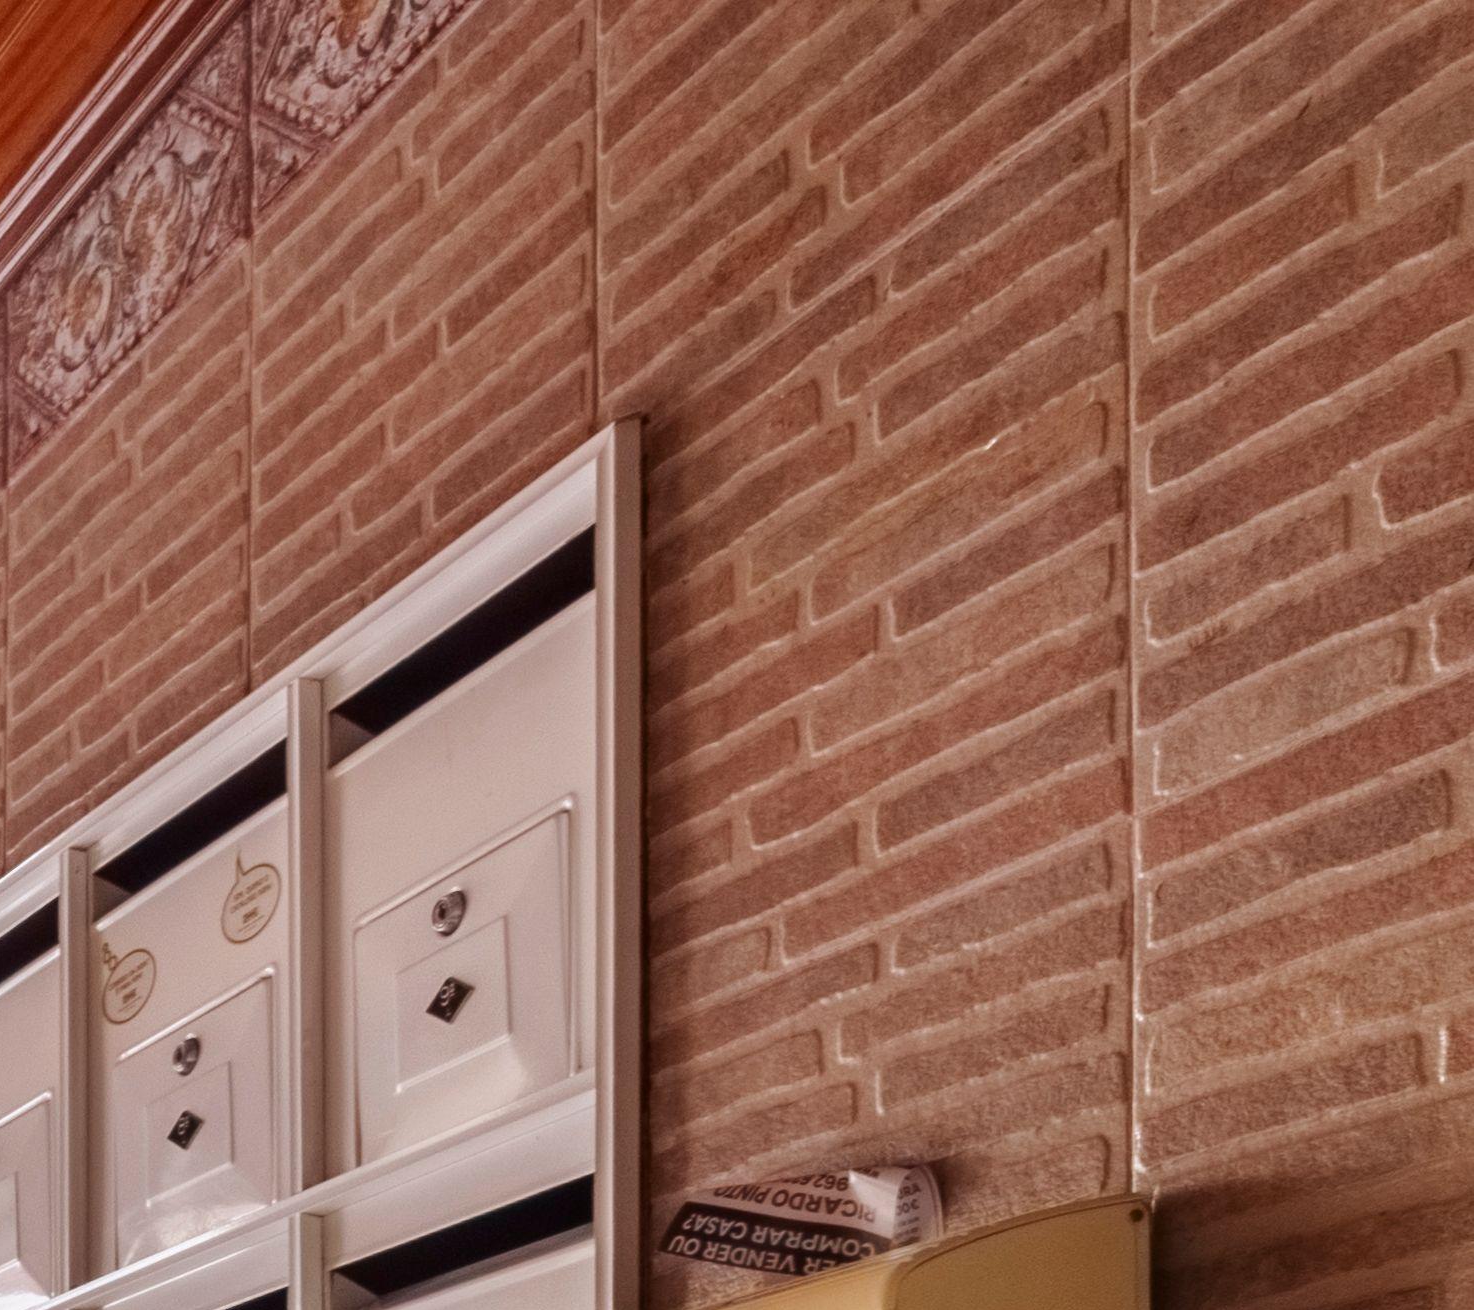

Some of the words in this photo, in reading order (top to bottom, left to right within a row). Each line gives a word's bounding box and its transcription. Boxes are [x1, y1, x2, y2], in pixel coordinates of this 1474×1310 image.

[682, 1212, 748, 1240] CASA?
[751, 1224, 876, 1258] COMPRAR
[668, 1235, 701, 1255] OU
[706, 1240, 796, 1274] VENDER
